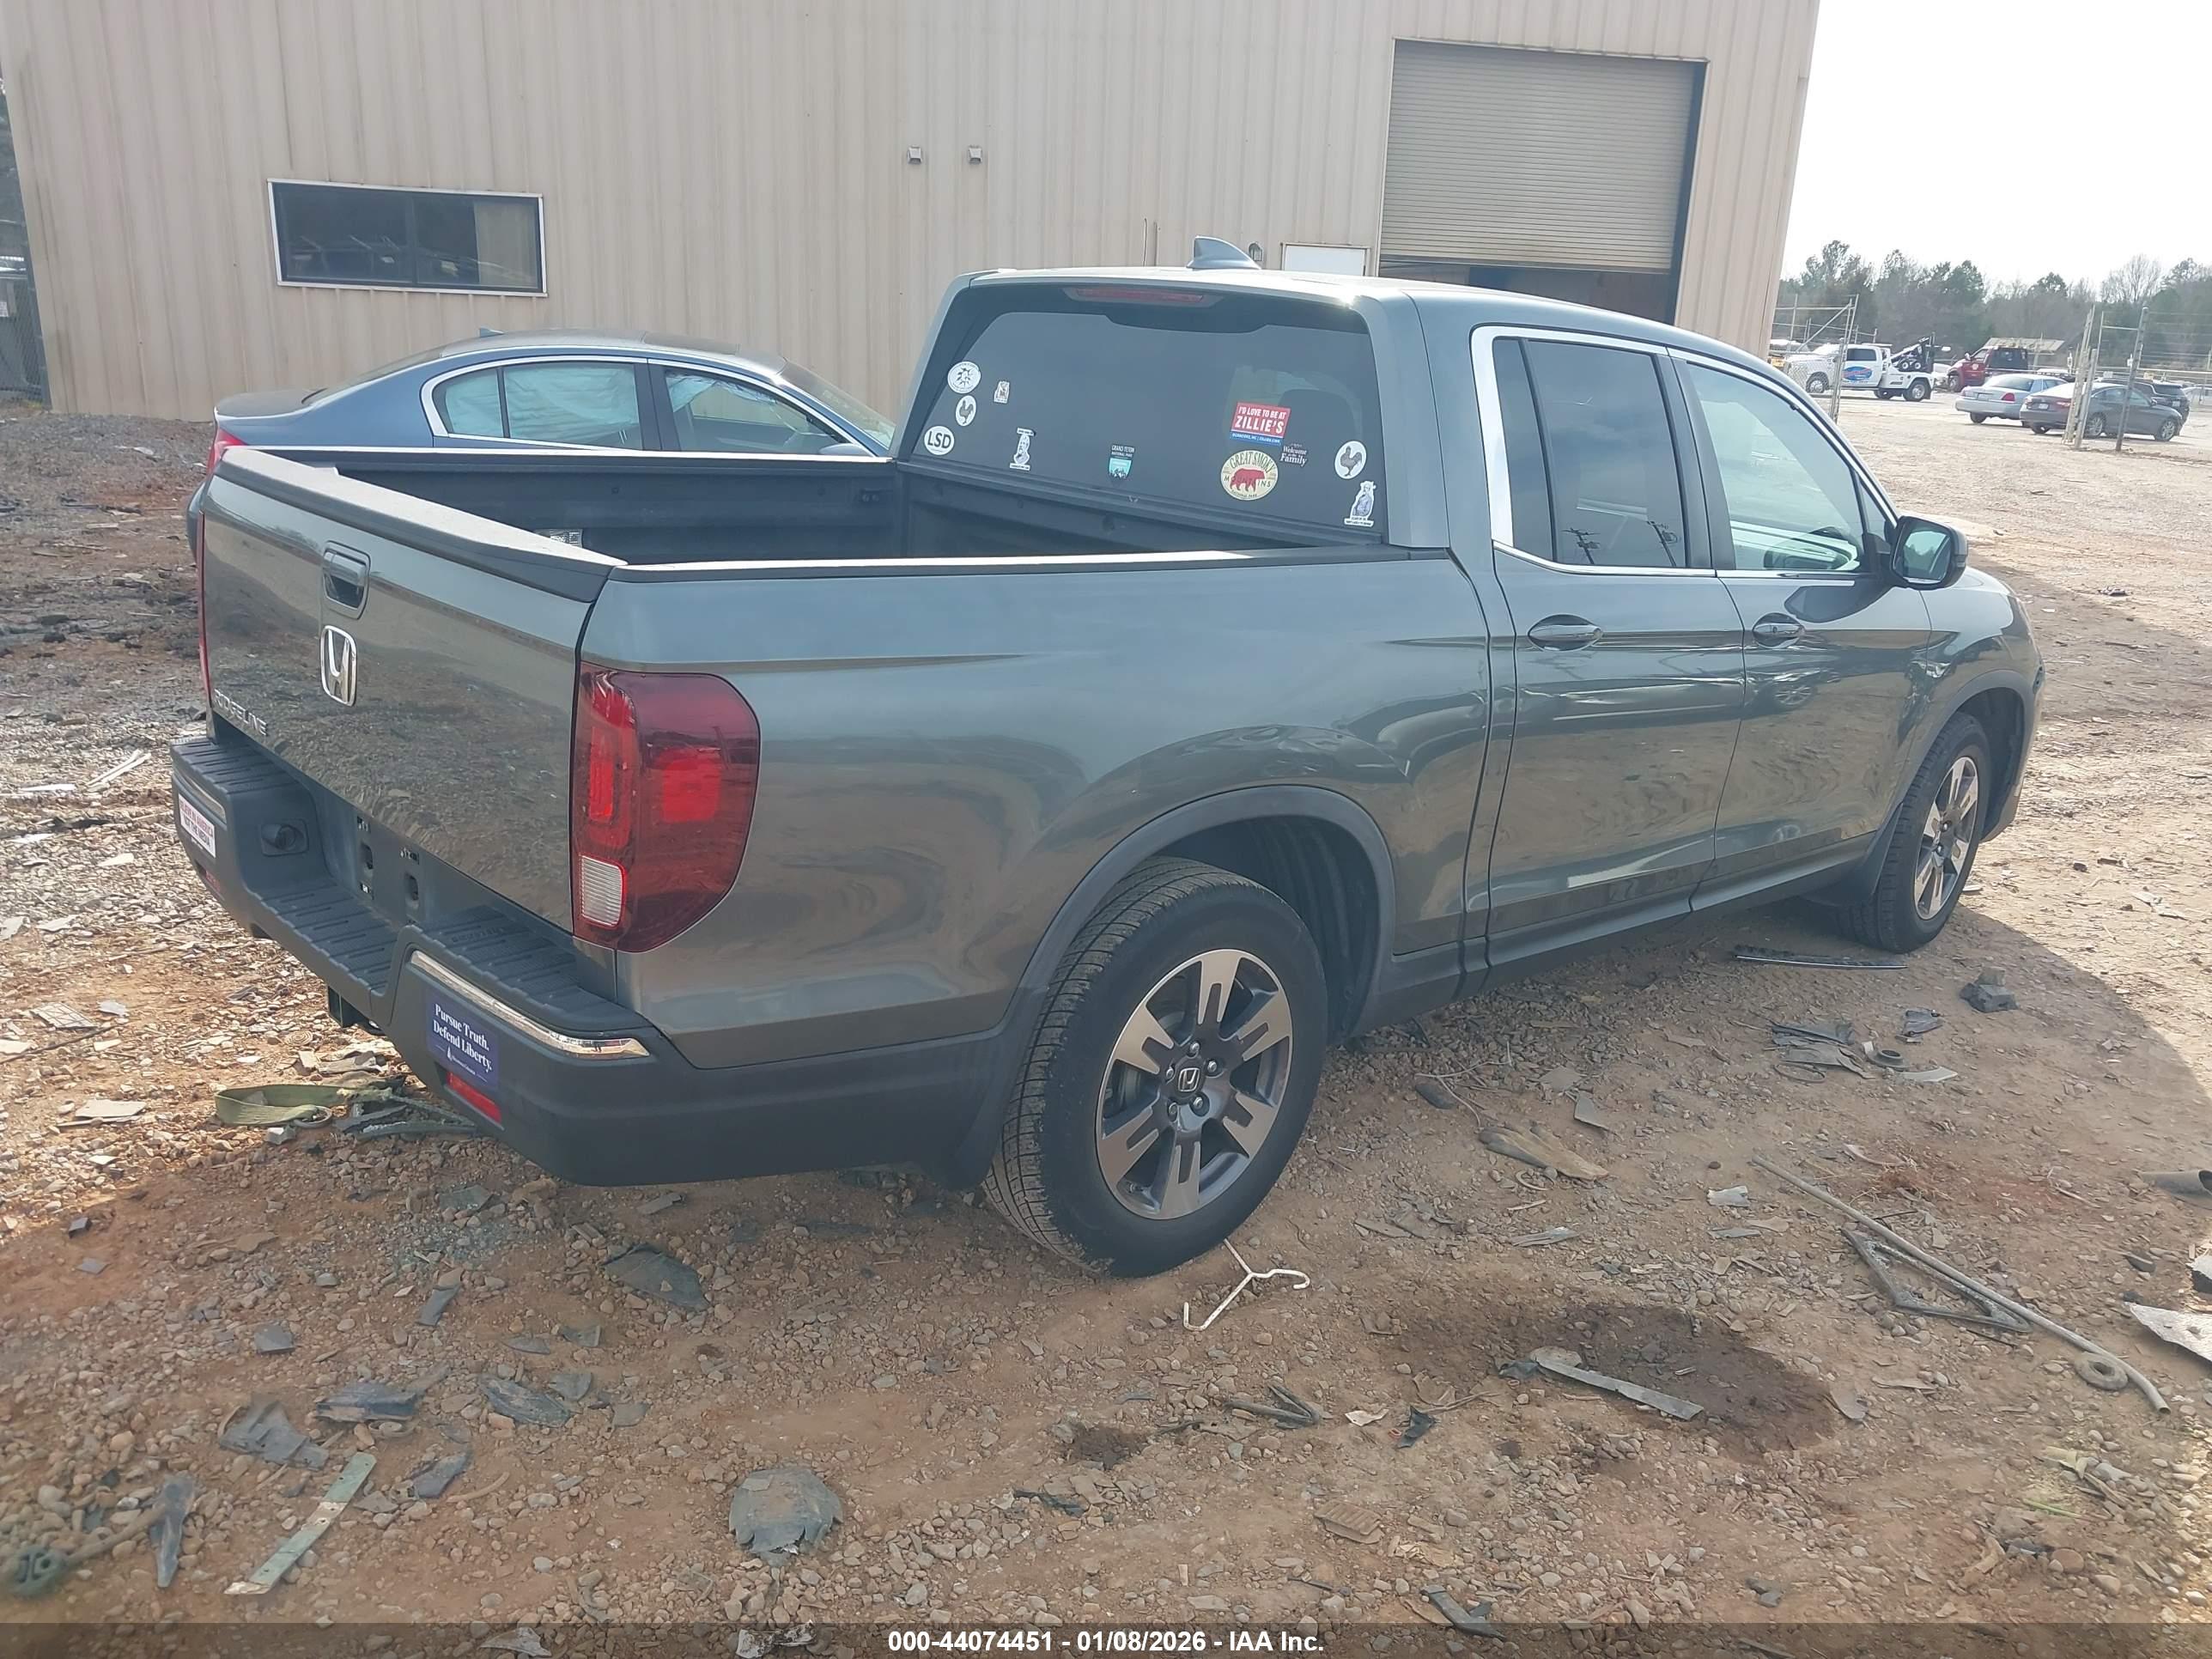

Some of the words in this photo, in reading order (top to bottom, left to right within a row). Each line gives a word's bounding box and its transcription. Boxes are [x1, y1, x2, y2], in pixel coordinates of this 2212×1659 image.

[1247, 407, 1261, 416] LOVE
[1262, 409, 1270, 417] TO
[1270, 410, 1278, 419] BE
[1279, 412, 1287, 420] AT
[1235, 416, 1284, 434] ZILLIE'S
[927, 431, 951, 449] LSD
[1283, 446, 1307, 455] Welcome
[1230, 451, 1253, 468] GREAT
[1254, 452, 1275, 473] SMOKY
[1280, 453, 1307, 467] Family
[435, 1003, 463, 1032] Pursue
[463, 1023, 490, 1051] Truth.
[433, 1019, 461, 1048] Defend
[462, 1038, 492, 1073] Liberty.
